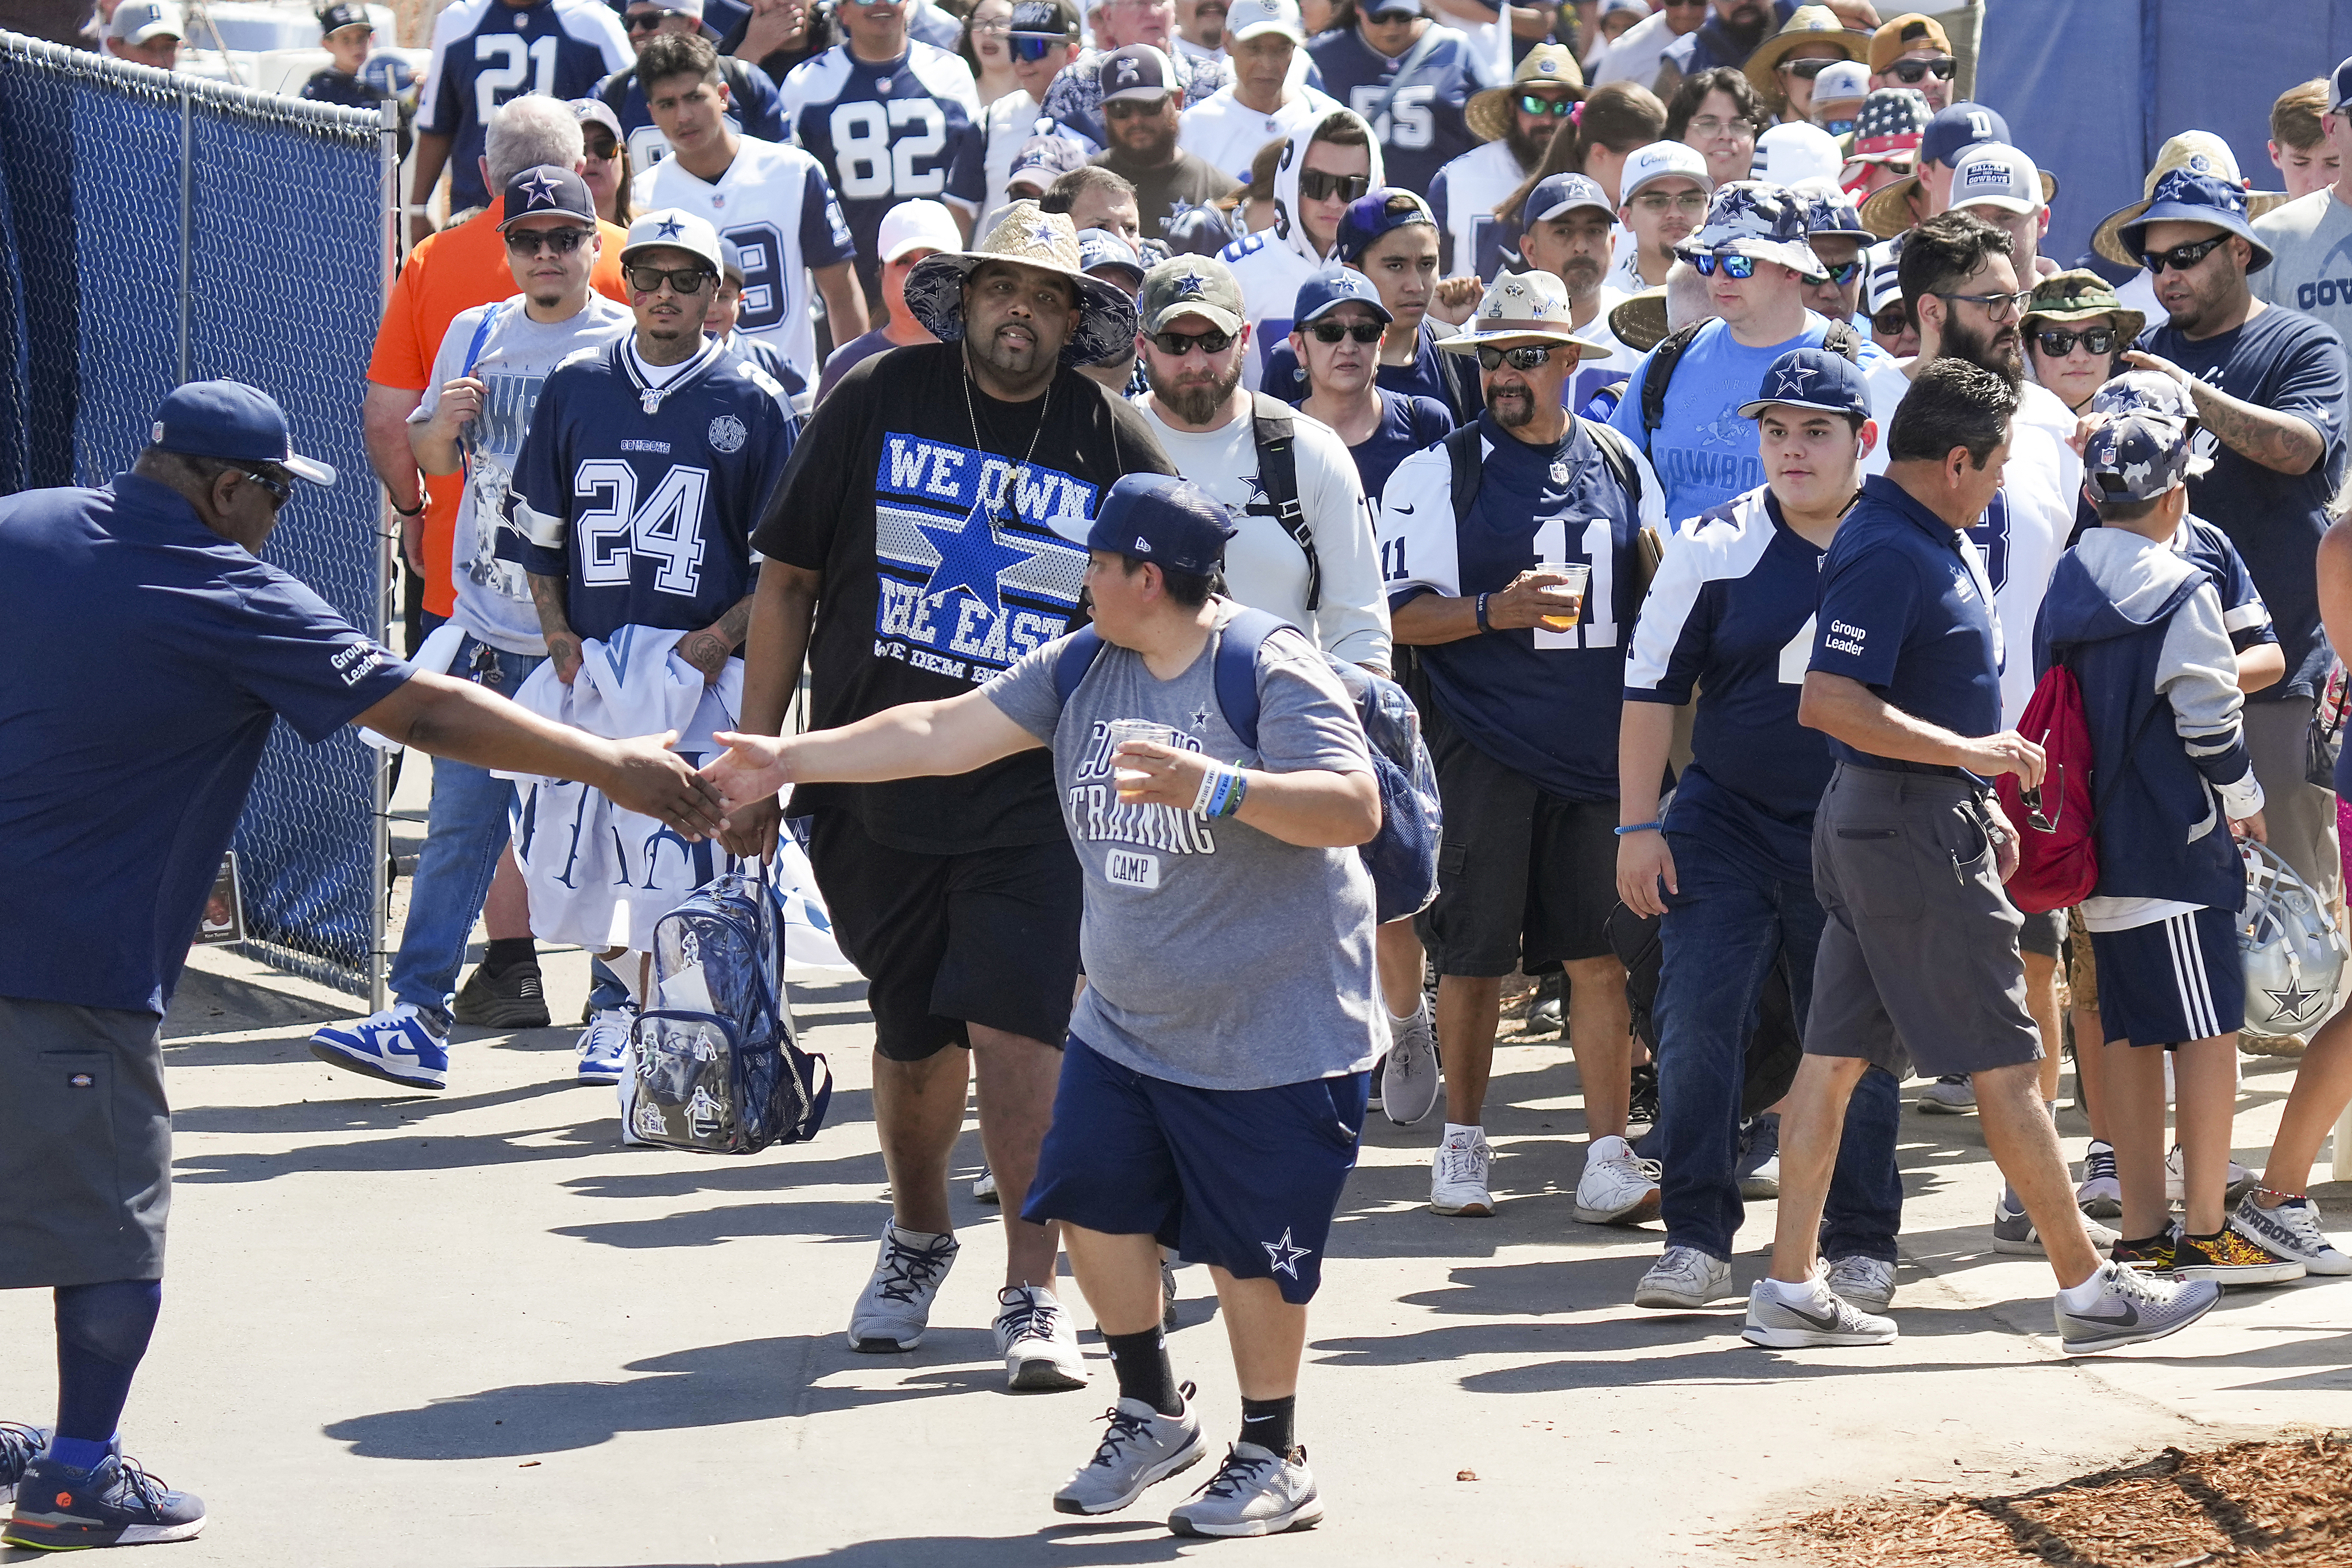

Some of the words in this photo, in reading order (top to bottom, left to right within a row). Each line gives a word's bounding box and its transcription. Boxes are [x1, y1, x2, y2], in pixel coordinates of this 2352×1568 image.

[475, 33, 558, 125] 21
[1967, 111, 1993, 138] D
[831, 98, 947, 199] 82
[1968, 175, 2008, 184] COWBOYS
[1971, 164, 2006, 172] DALLAS
[621, 439, 671, 454] COWBOYS
[889, 438, 965, 497] WE
[976, 459, 1091, 521] OWN
[575, 459, 709, 598] 24
[1382, 536, 1409, 582] 11
[1533, 518, 1618, 650] 11
[880, 577, 945, 644] THE
[949, 598, 1066, 664] EAST
[1831, 620, 1866, 641] Group
[330, 641, 369, 669] Group
[873, 639, 907, 661] WE
[909, 649, 966, 679] DEM
[1825, 634, 1864, 656] Leader
[341, 651, 383, 686] Leader
[1069, 784, 1217, 855] TRAINING
[1112, 854, 1148, 883] CAMP
